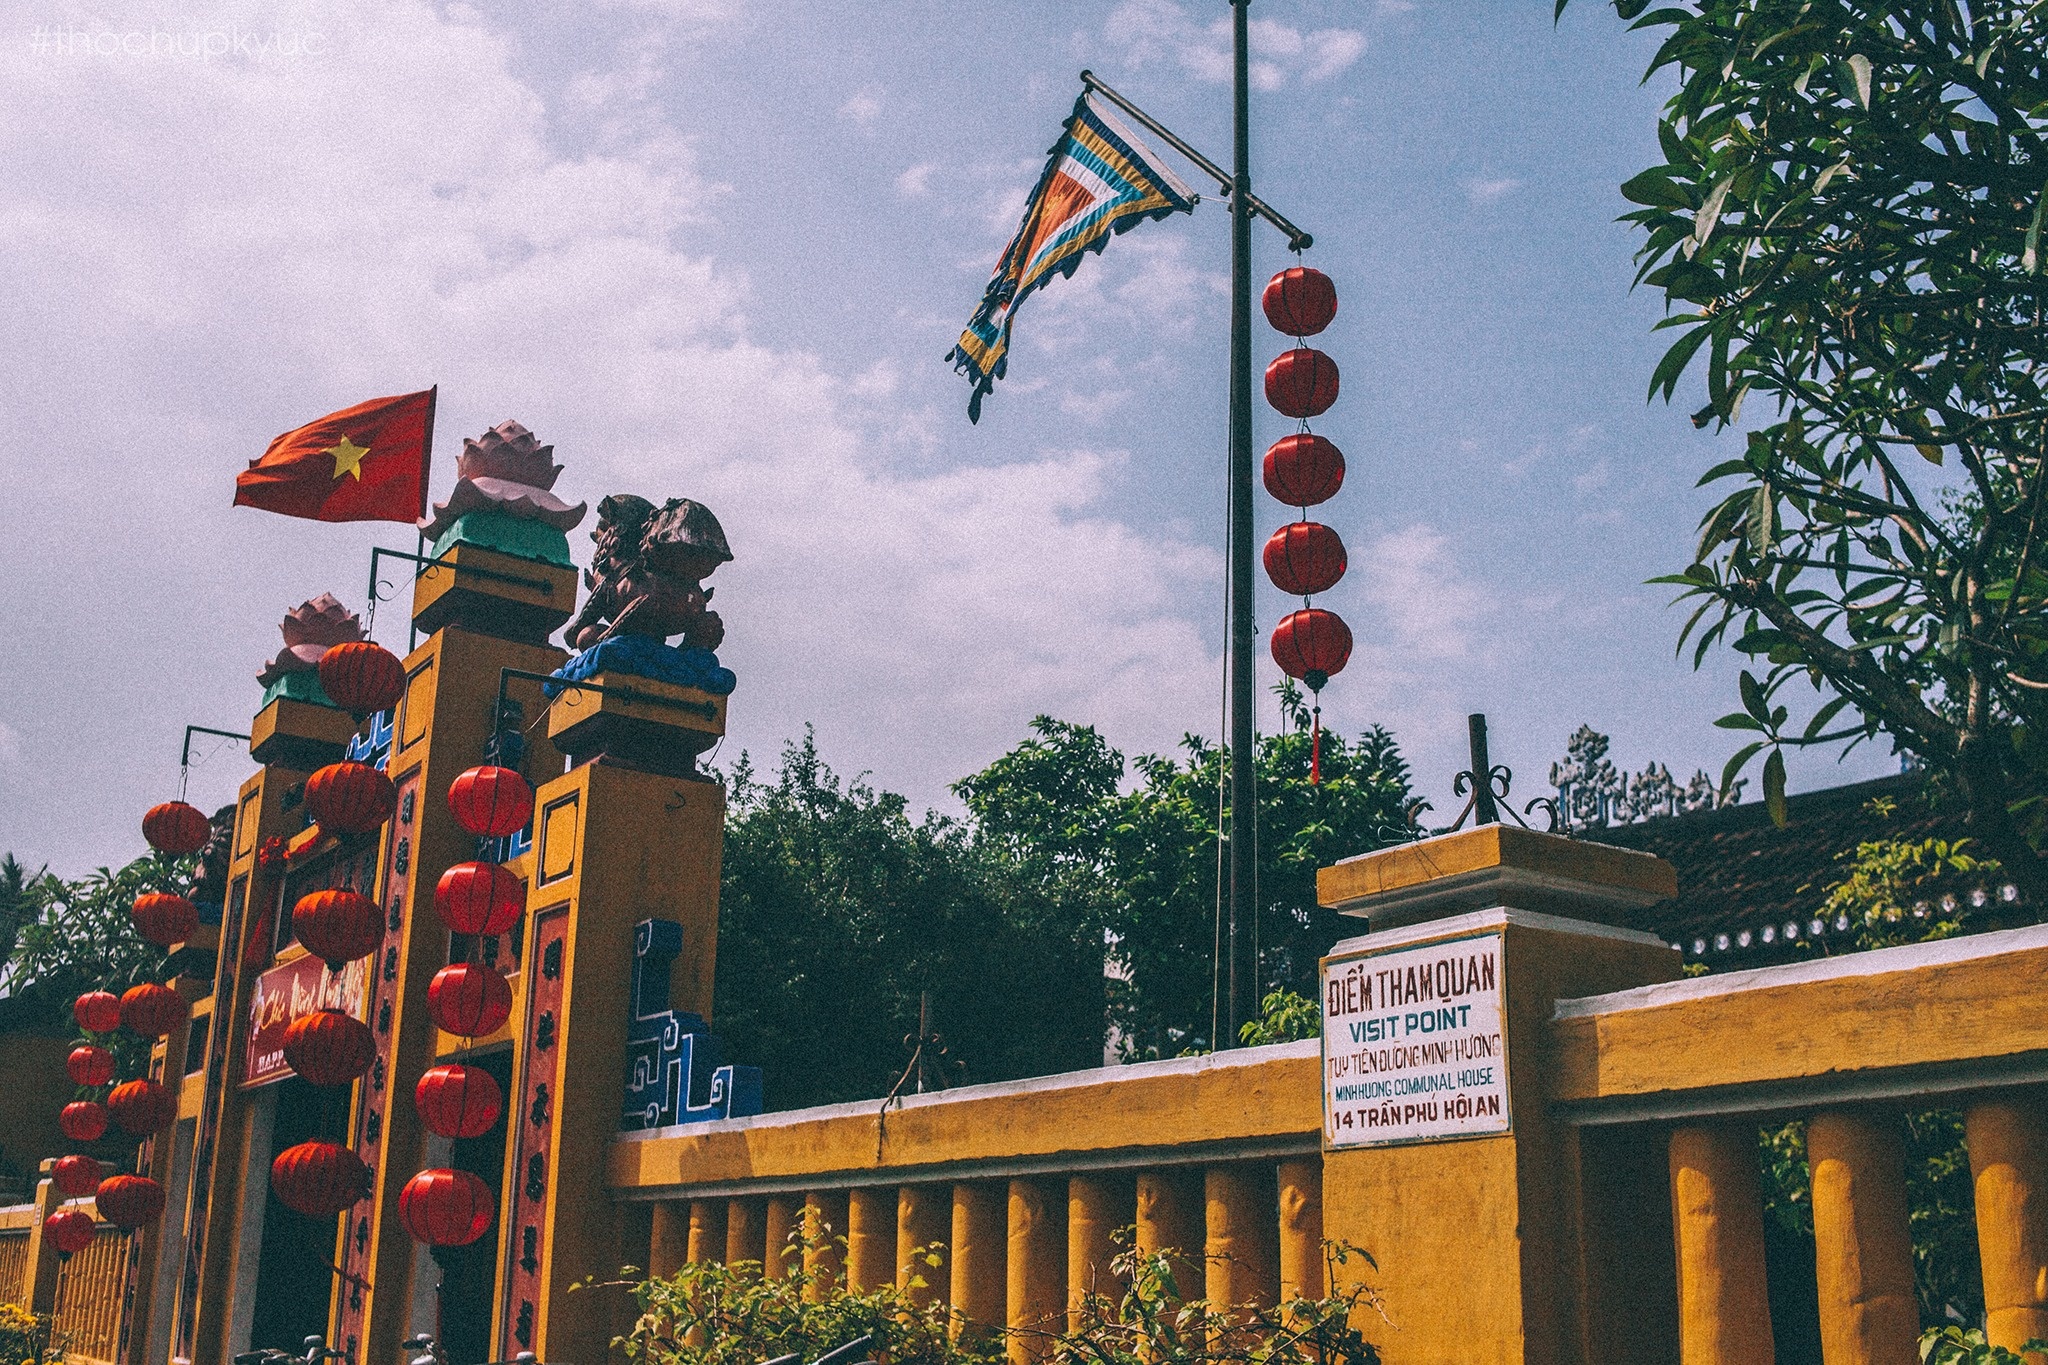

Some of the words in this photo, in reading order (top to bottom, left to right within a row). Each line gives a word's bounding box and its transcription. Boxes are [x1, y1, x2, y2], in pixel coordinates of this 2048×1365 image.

[1328, 963, 1373, 1017] ĐIỂM
[1349, 1015, 1400, 1043] VISIT
[1405, 1004, 1471, 1036] POINT
[257, 1049, 287, 1074] HAPP
[1351, 1048, 1378, 1074] TIÊN
[1422, 1040, 1453, 1066] MINH
[1394, 1072, 1456, 1096] COMMUNAL
[1458, 1067, 1494, 1088] HOUSE
[1334, 1111, 1354, 1130] 14
[1405, 1093, 1438, 1124] PHÚ
[1444, 1093, 1472, 1124] HỘI
[1475, 1094, 1500, 1117] AN
